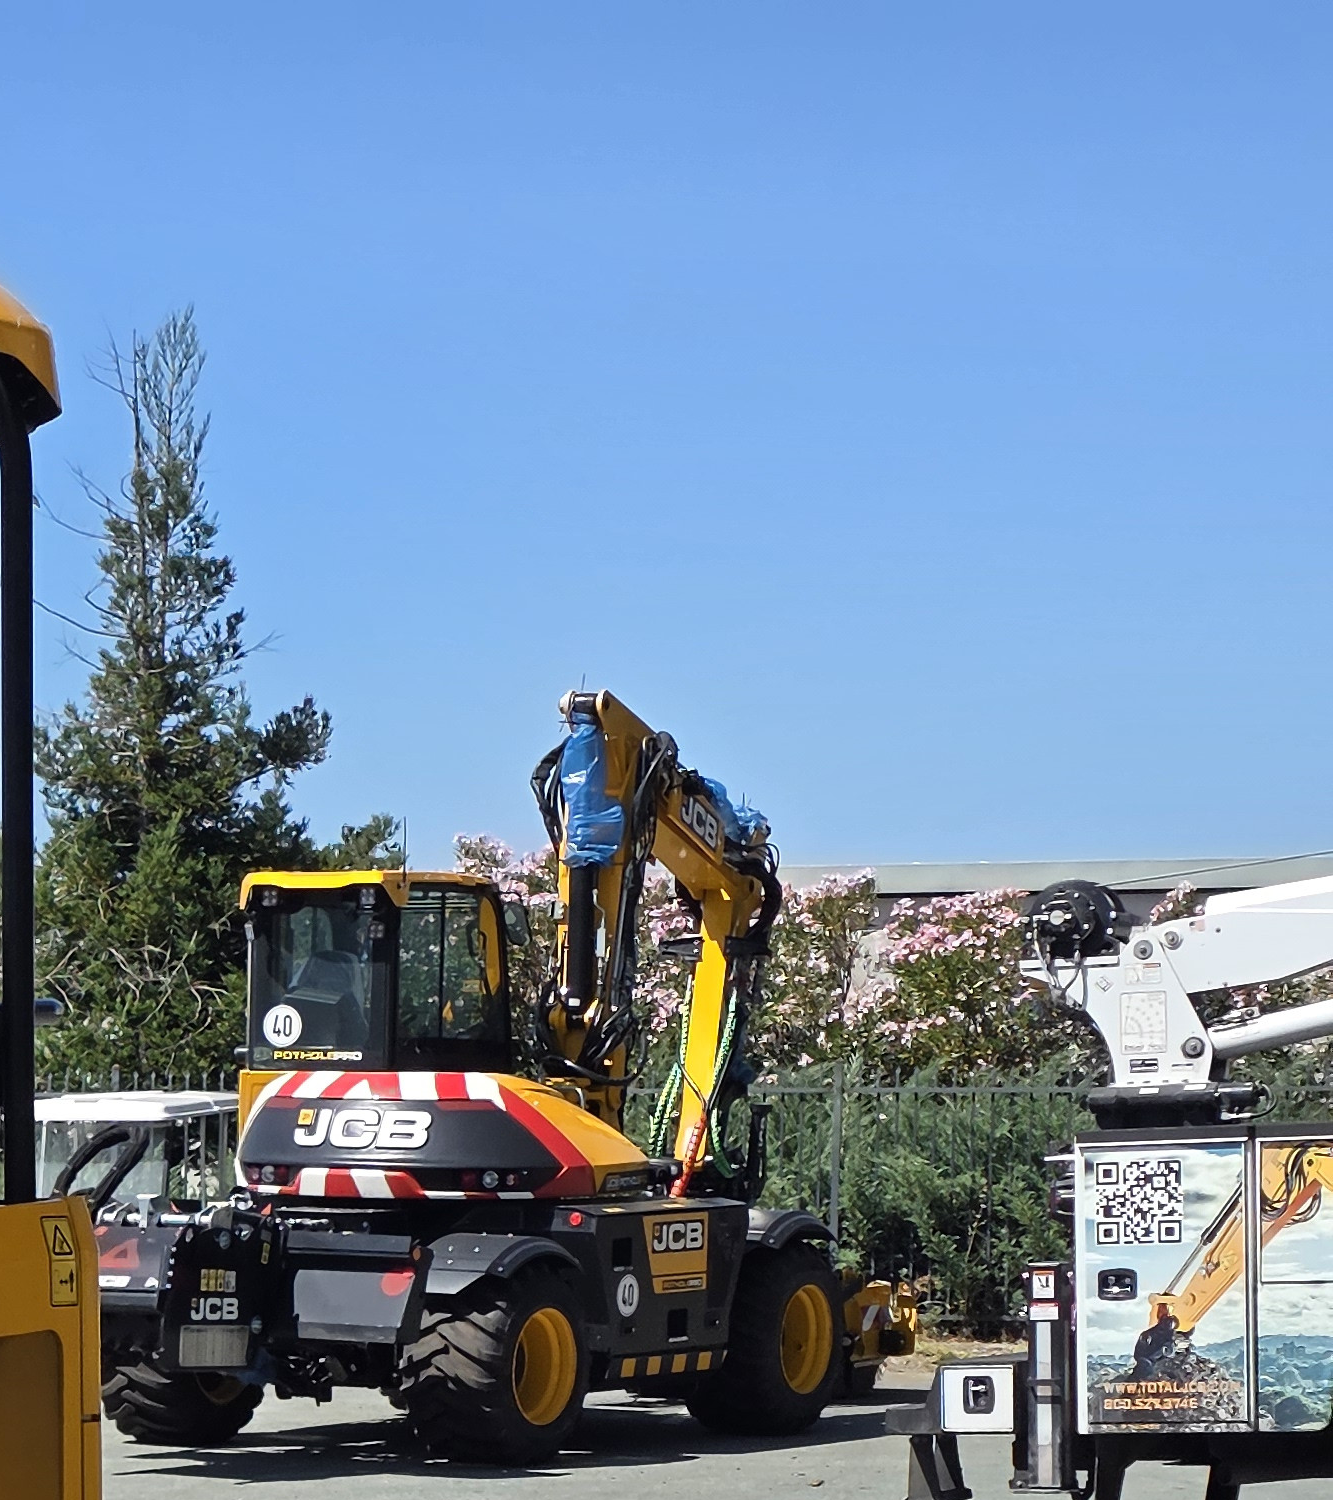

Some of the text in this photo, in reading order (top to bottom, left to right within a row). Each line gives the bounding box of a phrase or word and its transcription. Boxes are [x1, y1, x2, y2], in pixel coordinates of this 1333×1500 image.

[682, 796, 718, 849] JCB
[273, 1014, 293, 1037] 40
[294, 1108, 432, 1149] JCB
[653, 1222, 703, 1251] JCB
[622, 1283, 633, 1307] 40
[190, 1297, 239, 1321] JCB
